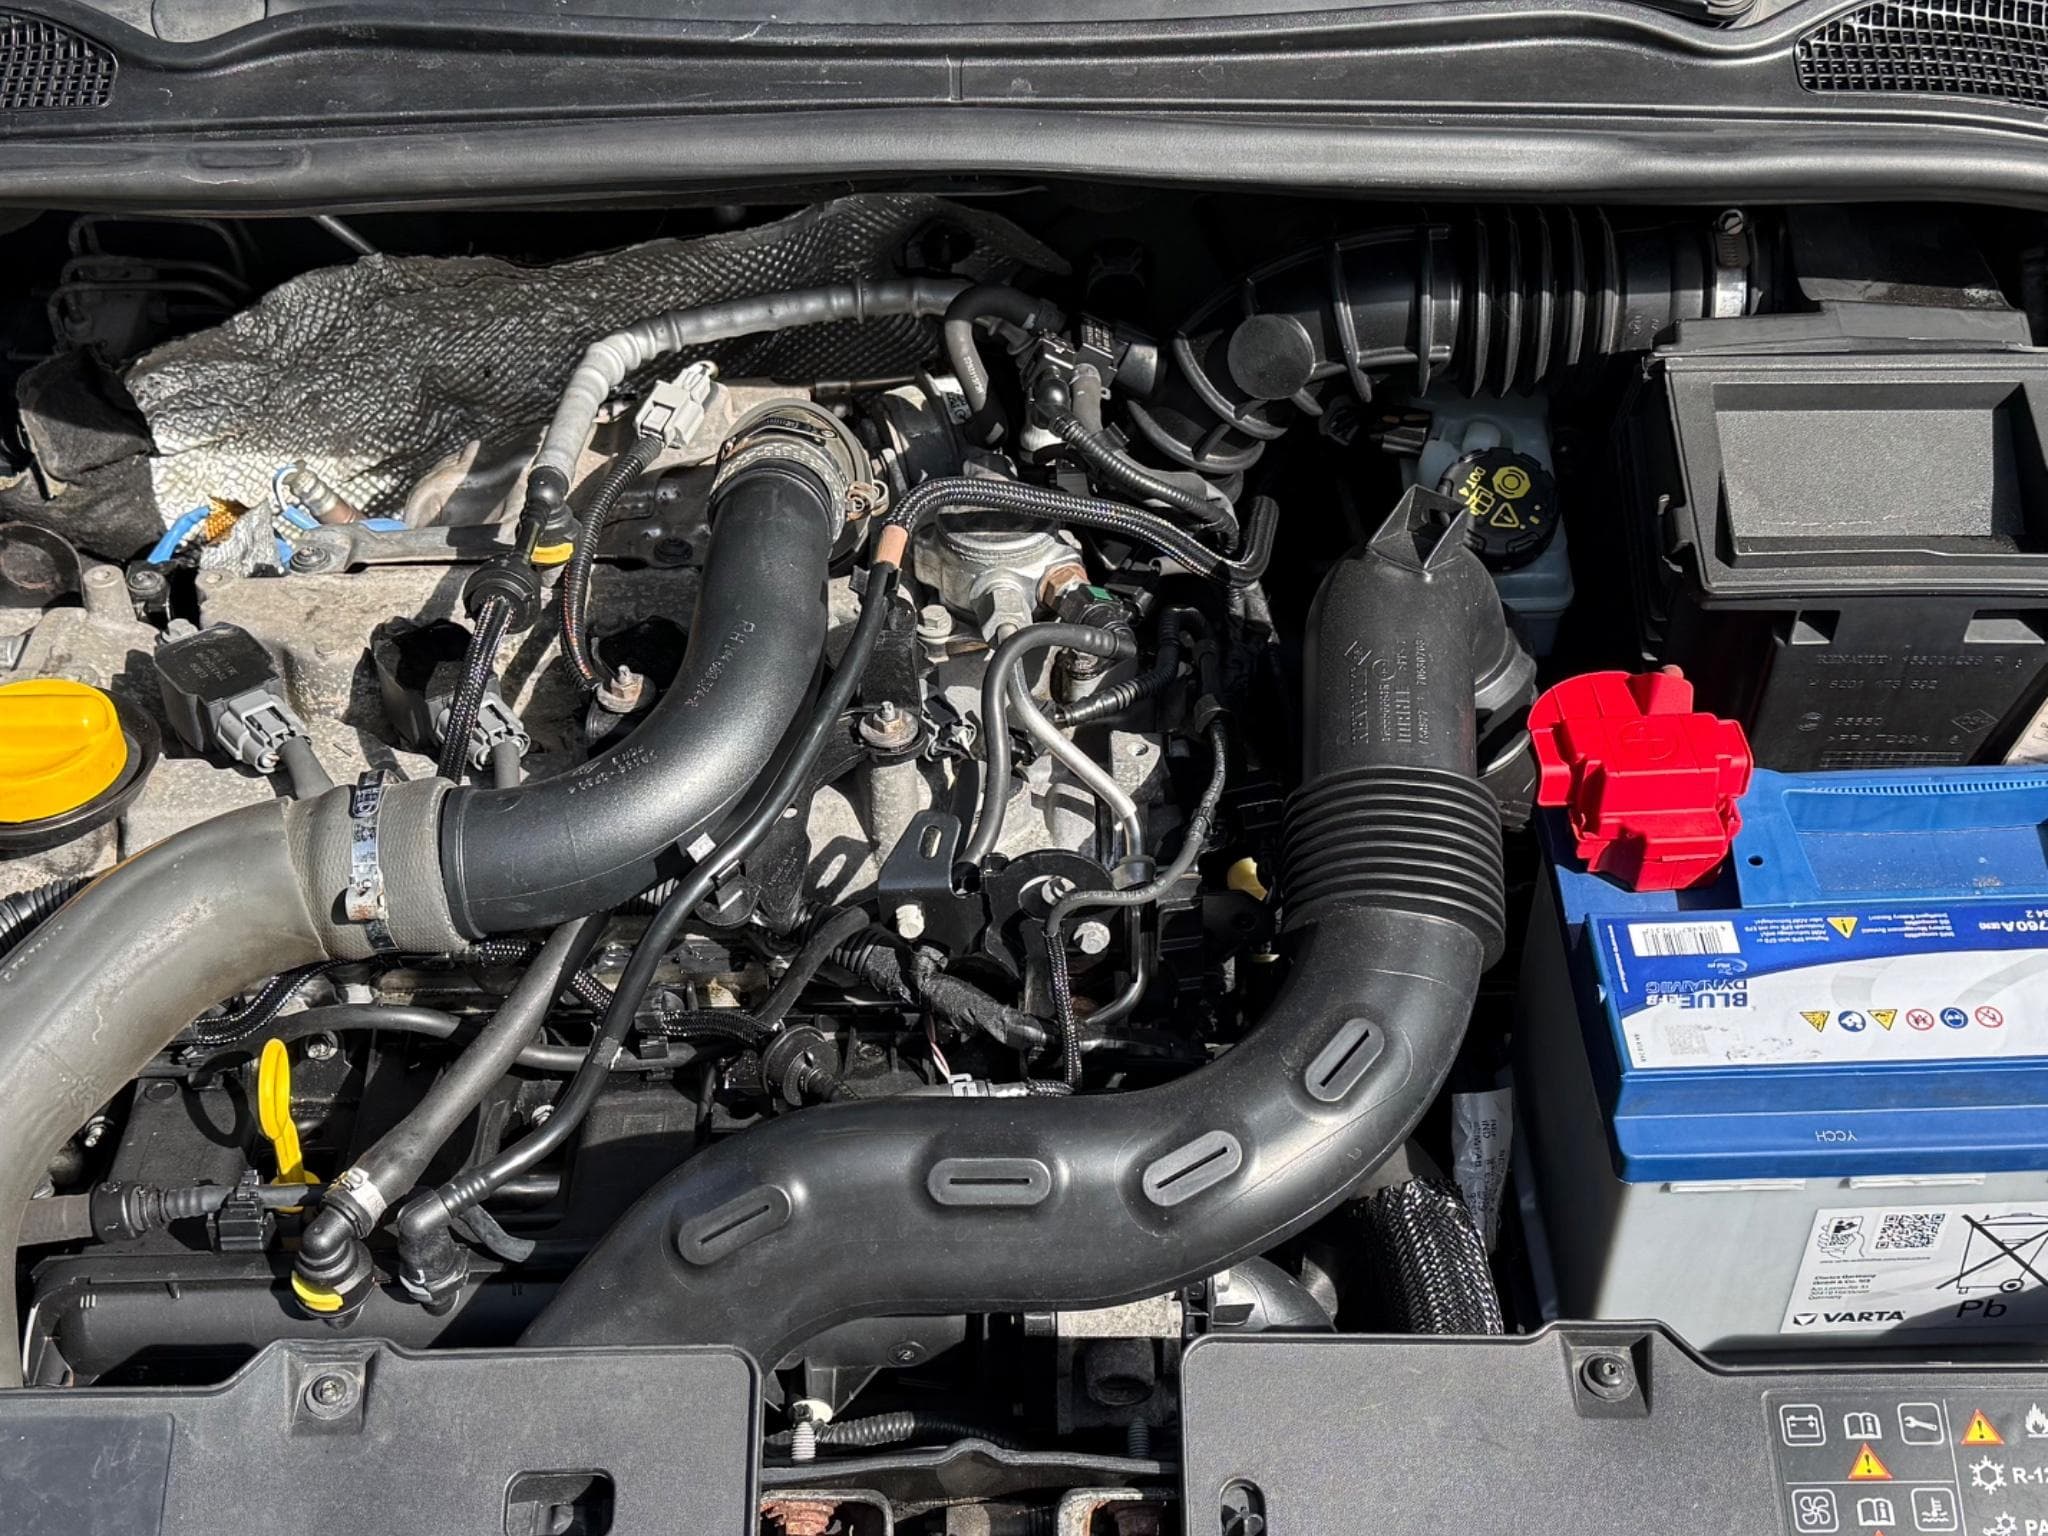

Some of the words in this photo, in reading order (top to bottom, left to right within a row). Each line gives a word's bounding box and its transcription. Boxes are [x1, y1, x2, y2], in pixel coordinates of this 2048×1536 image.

[1466, 466, 1487, 489] DOT
[1645, 979, 1748, 994] DYNAMIC
[1680, 991, 1748, 1009] BLUE
[1815, 1129, 1859, 1142] YCCH
[1957, 1299, 2008, 1318] Pb
[1823, 1311, 1902, 1323] VARTA
